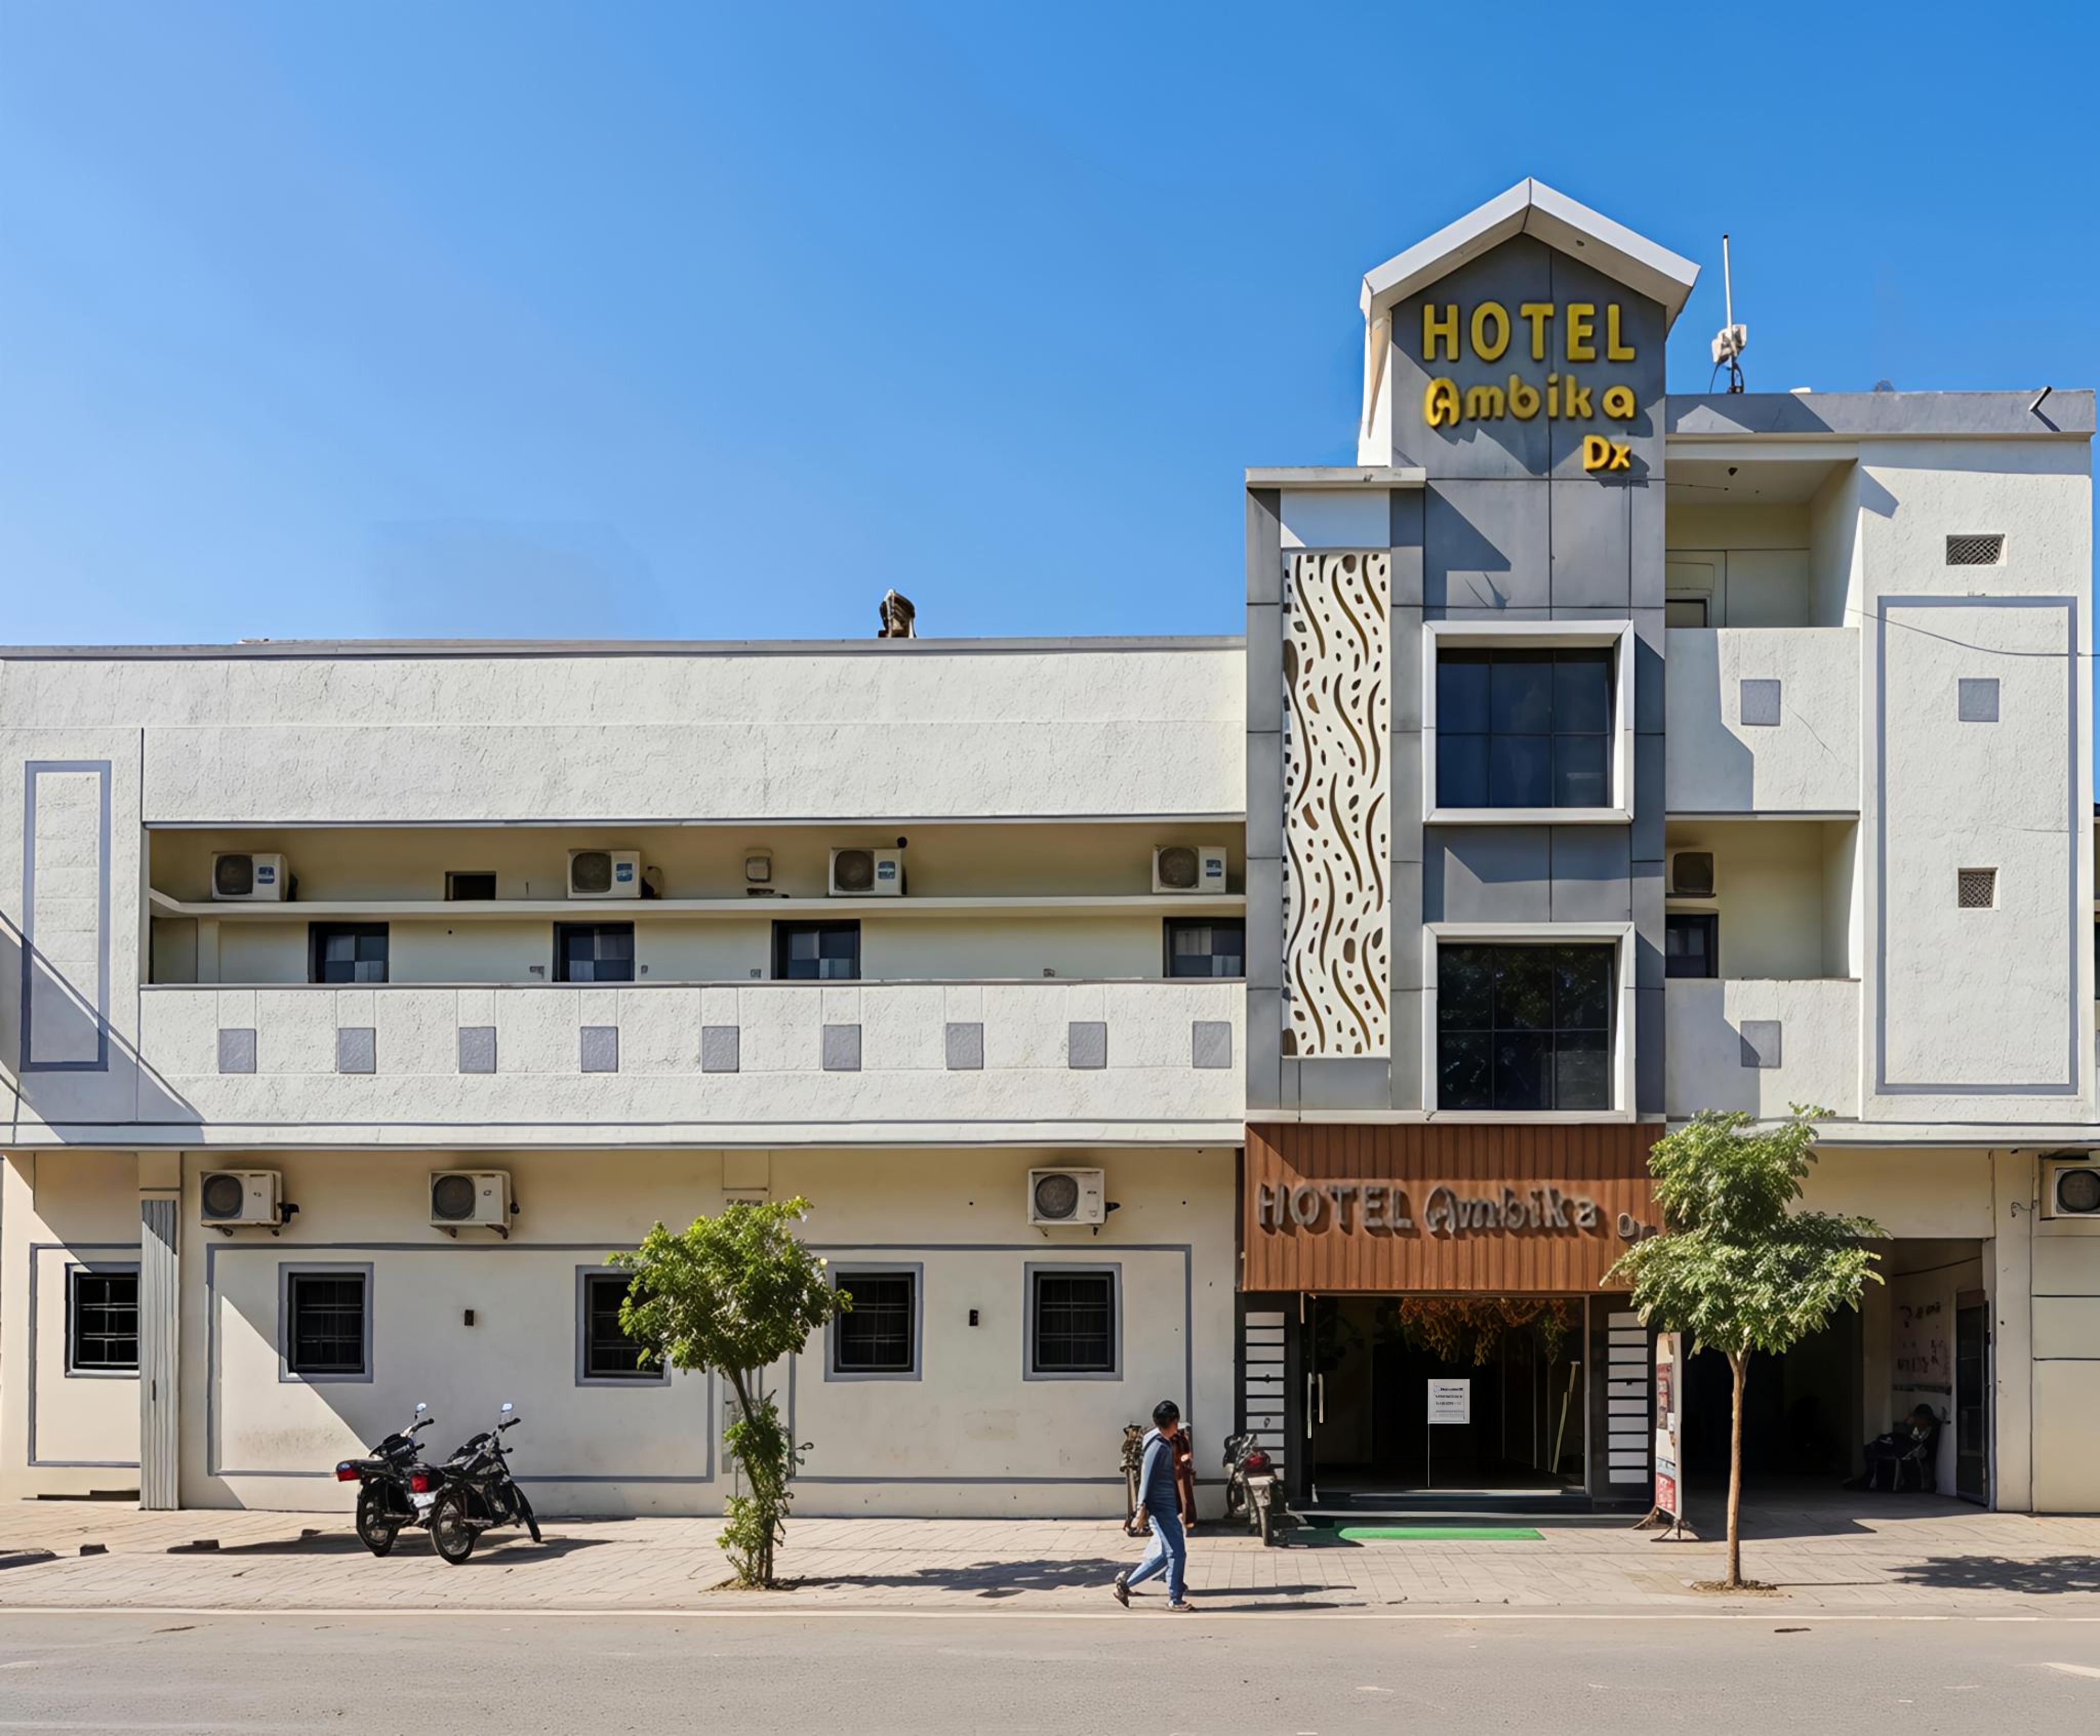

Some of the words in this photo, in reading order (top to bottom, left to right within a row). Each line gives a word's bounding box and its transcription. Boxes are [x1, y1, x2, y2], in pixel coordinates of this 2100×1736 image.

[1423, 301, 1635, 361] HOTEL
[1425, 373, 1635, 426] Ambika
[1583, 435, 1632, 470] Dx
[1258, 1182, 1411, 1227] HOTEL
[1424, 1185, 1596, 1232] Ambika
